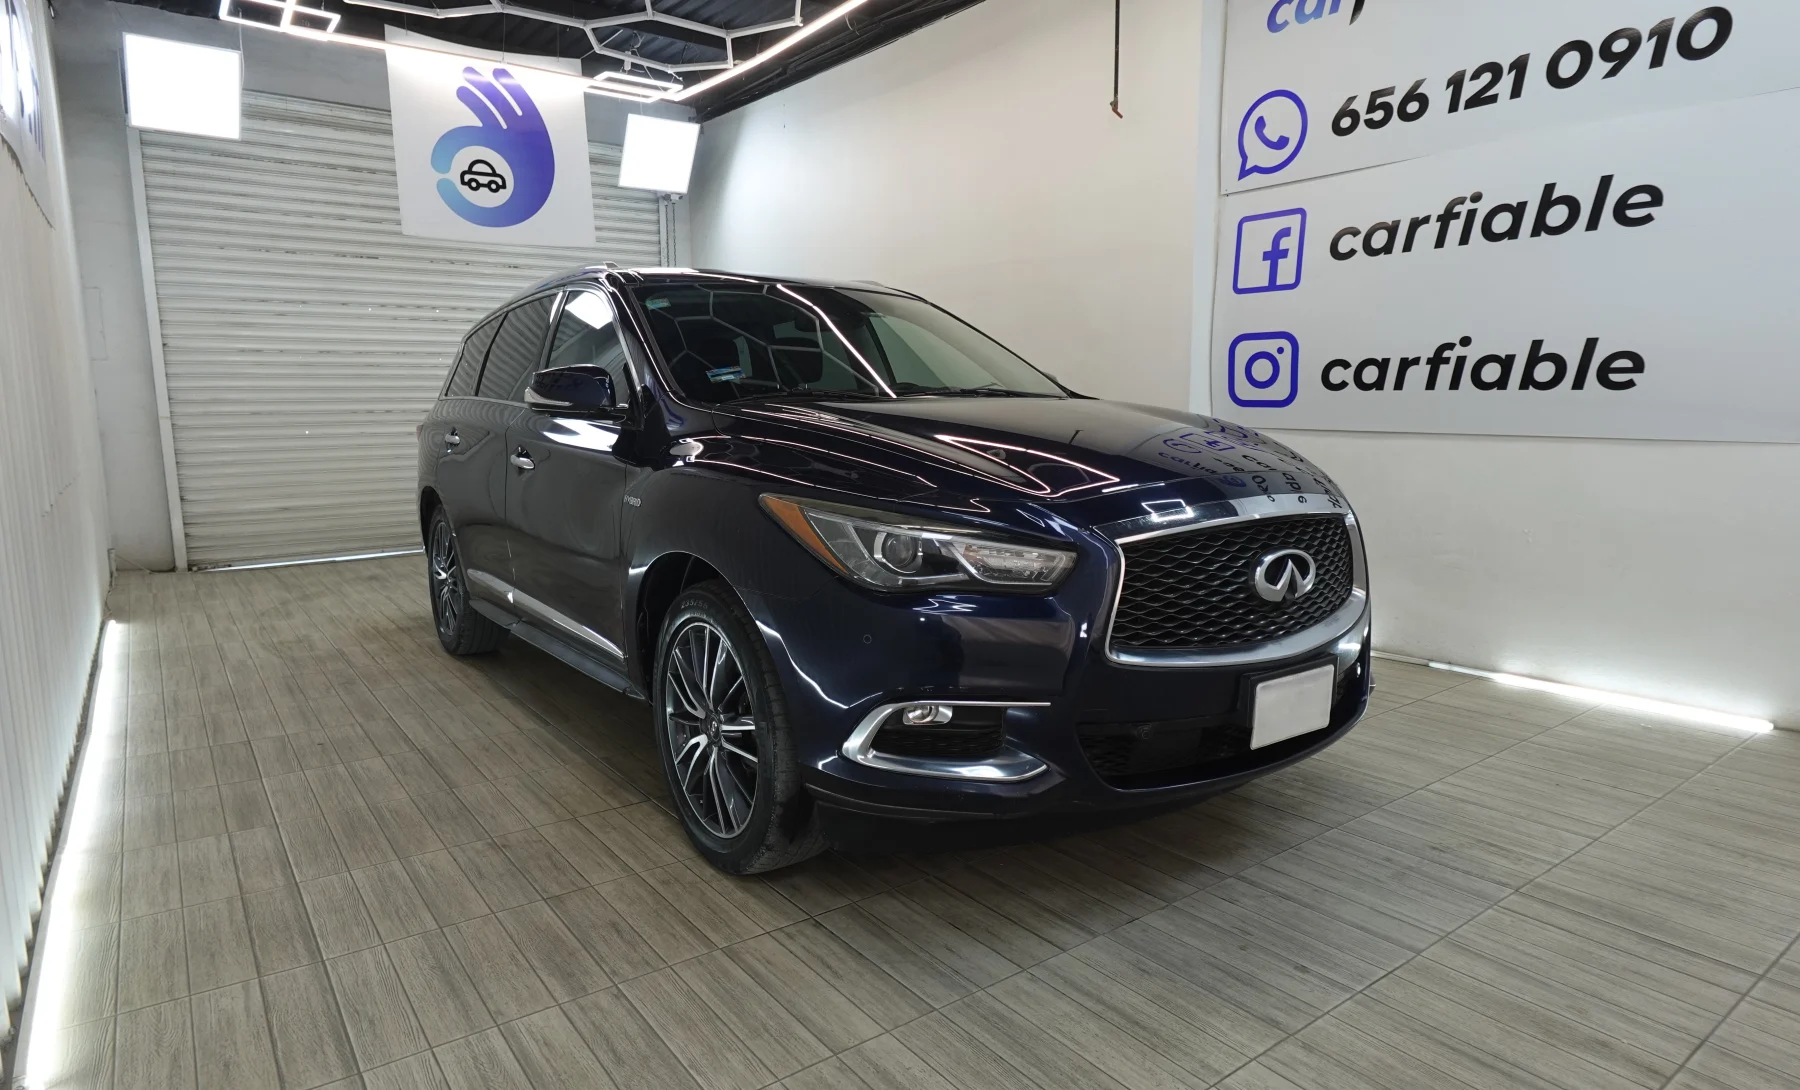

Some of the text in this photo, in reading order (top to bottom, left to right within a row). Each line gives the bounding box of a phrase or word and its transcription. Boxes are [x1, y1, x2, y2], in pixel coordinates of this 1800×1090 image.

[1331, 6, 1733, 137] 656 121 0910
[1329, 173, 1665, 262] carfiable
[1320, 335, 1646, 392] carfiable
